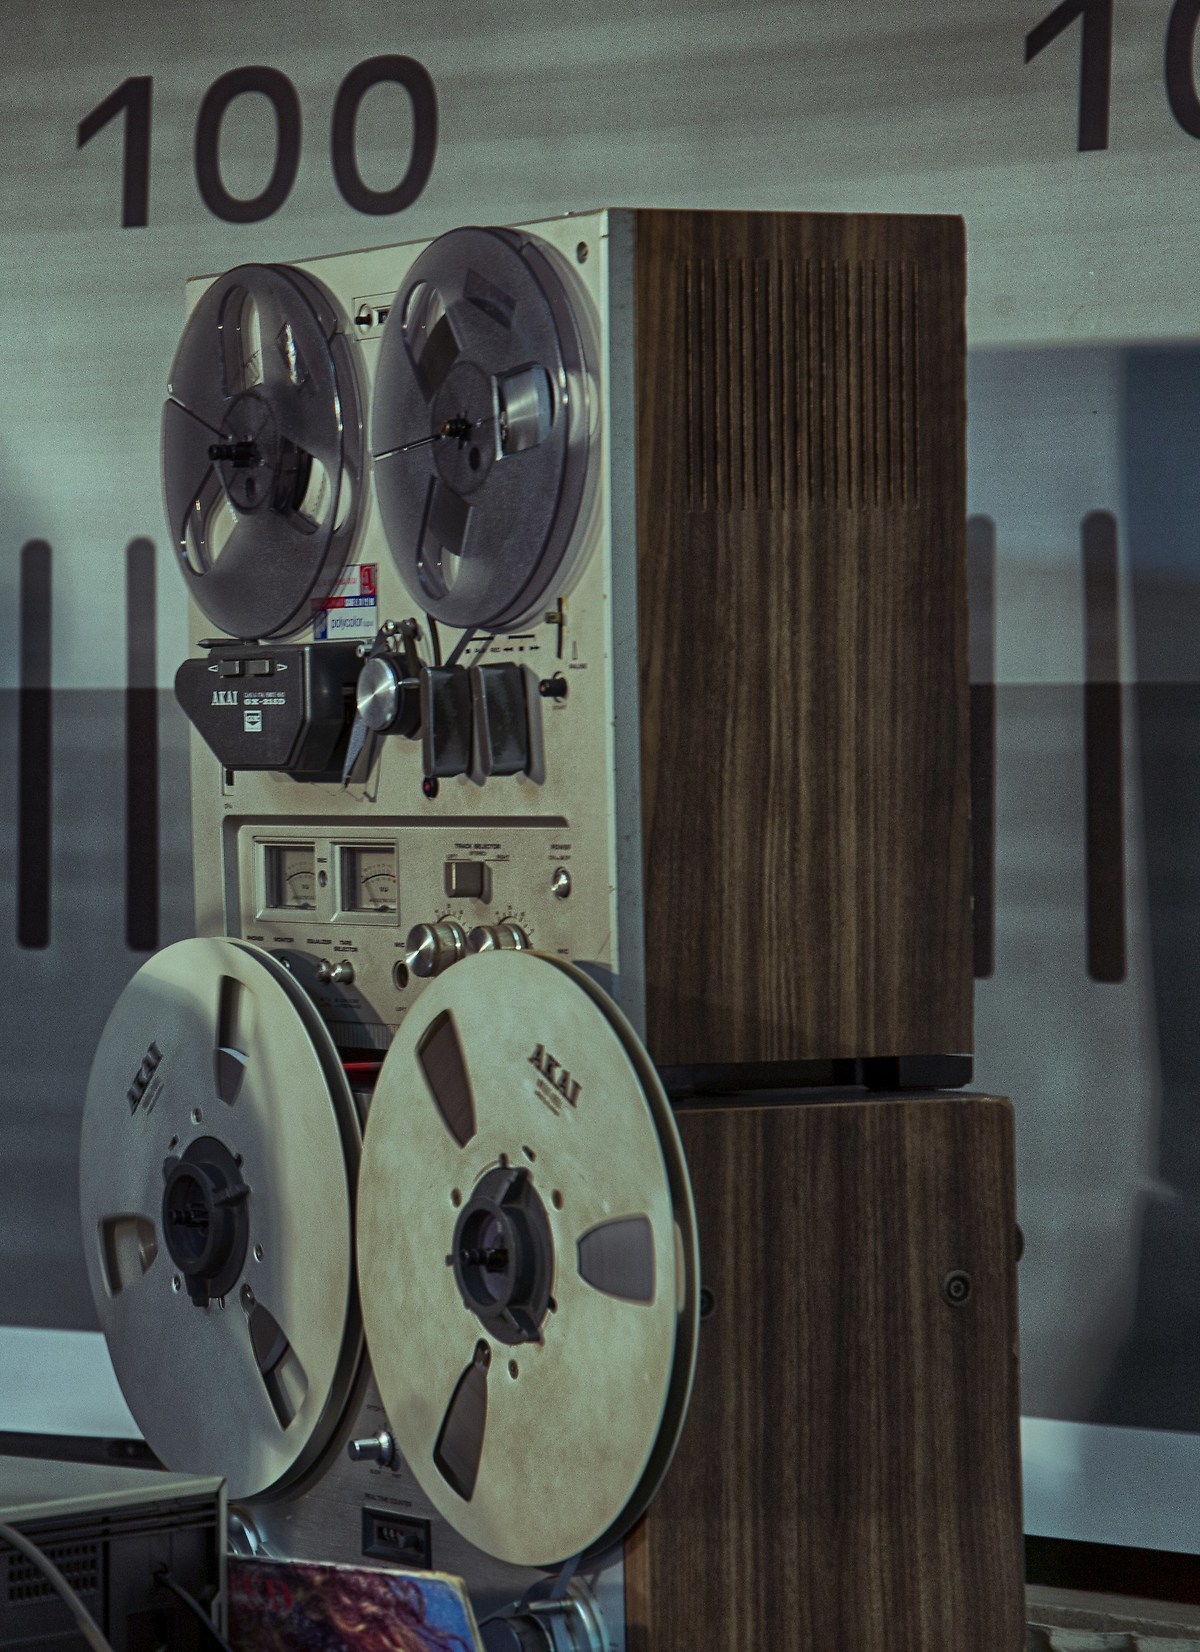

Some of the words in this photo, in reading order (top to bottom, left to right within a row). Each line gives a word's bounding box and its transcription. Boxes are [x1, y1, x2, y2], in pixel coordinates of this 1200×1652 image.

[76, 54, 439, 229] 100
[211, 690, 238, 706] AKAI
[127, 1040, 164, 1116] AKAI
[528, 1043, 583, 1109] AKAI
